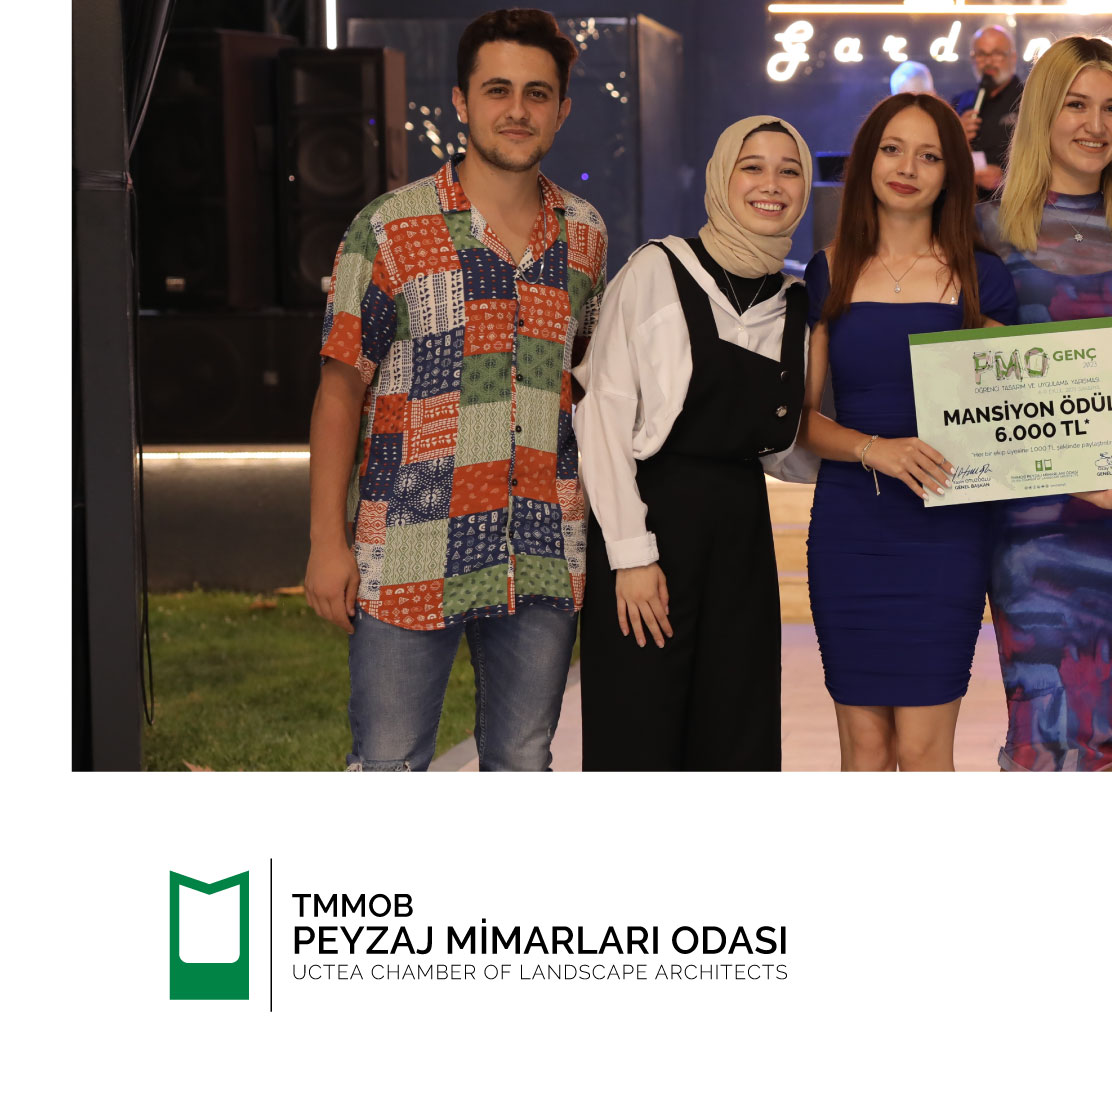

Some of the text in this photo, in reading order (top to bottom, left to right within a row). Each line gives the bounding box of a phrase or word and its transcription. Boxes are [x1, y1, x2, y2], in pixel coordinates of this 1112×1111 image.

[972, 347, 1097, 386] PMO GENÇ
[943, 399, 1055, 427] MANSİYON
[995, 422, 1057, 443] 6.000
